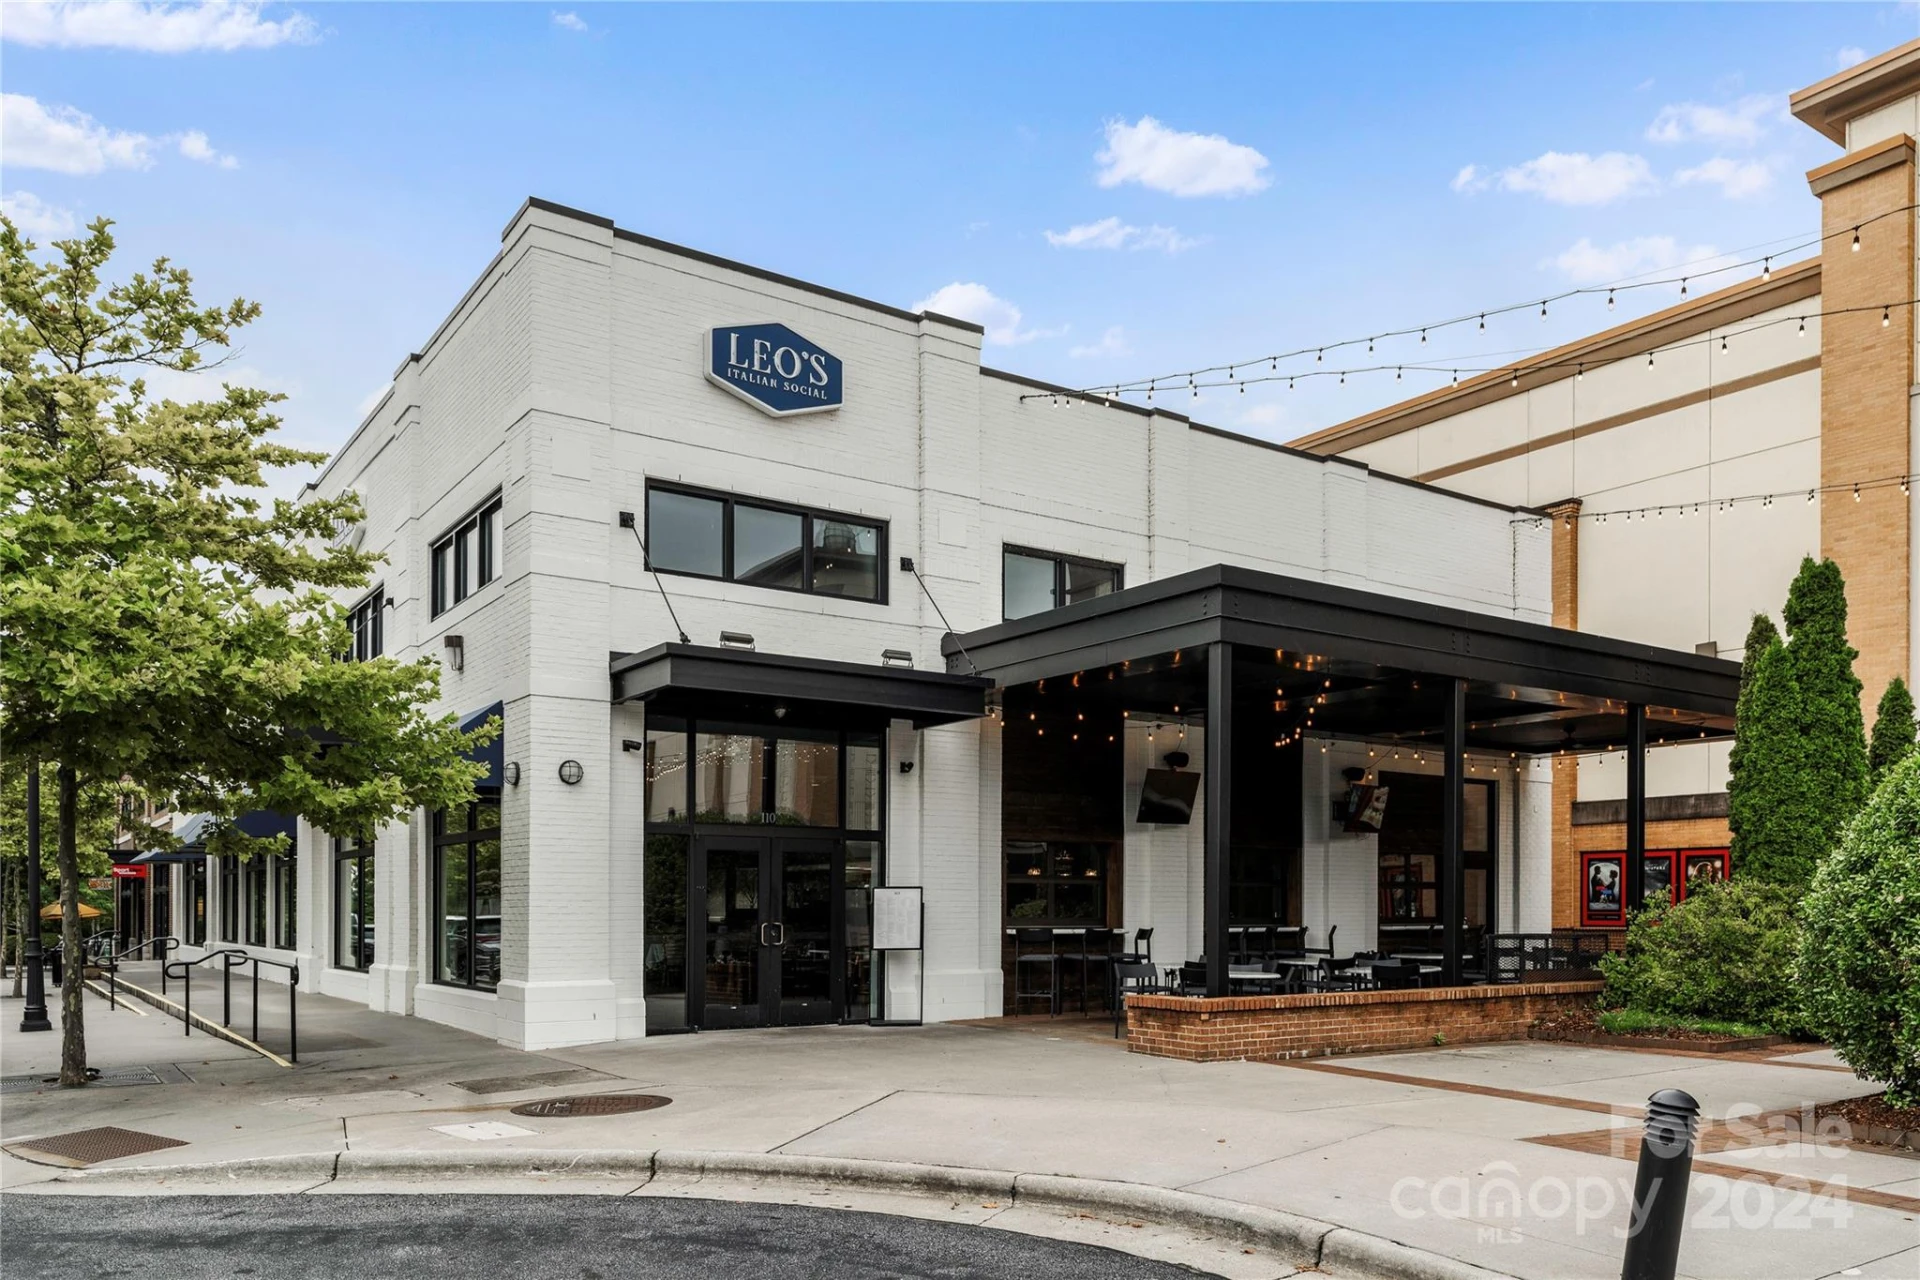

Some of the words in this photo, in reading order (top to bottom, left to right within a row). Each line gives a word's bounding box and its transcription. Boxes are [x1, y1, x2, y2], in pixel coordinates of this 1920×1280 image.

[727, 332, 829, 386] LEO'S
[727, 367, 778, 388] ITALIAN
[783, 381, 828, 400] SOCIAL
[761, 812, 777, 824] 110
